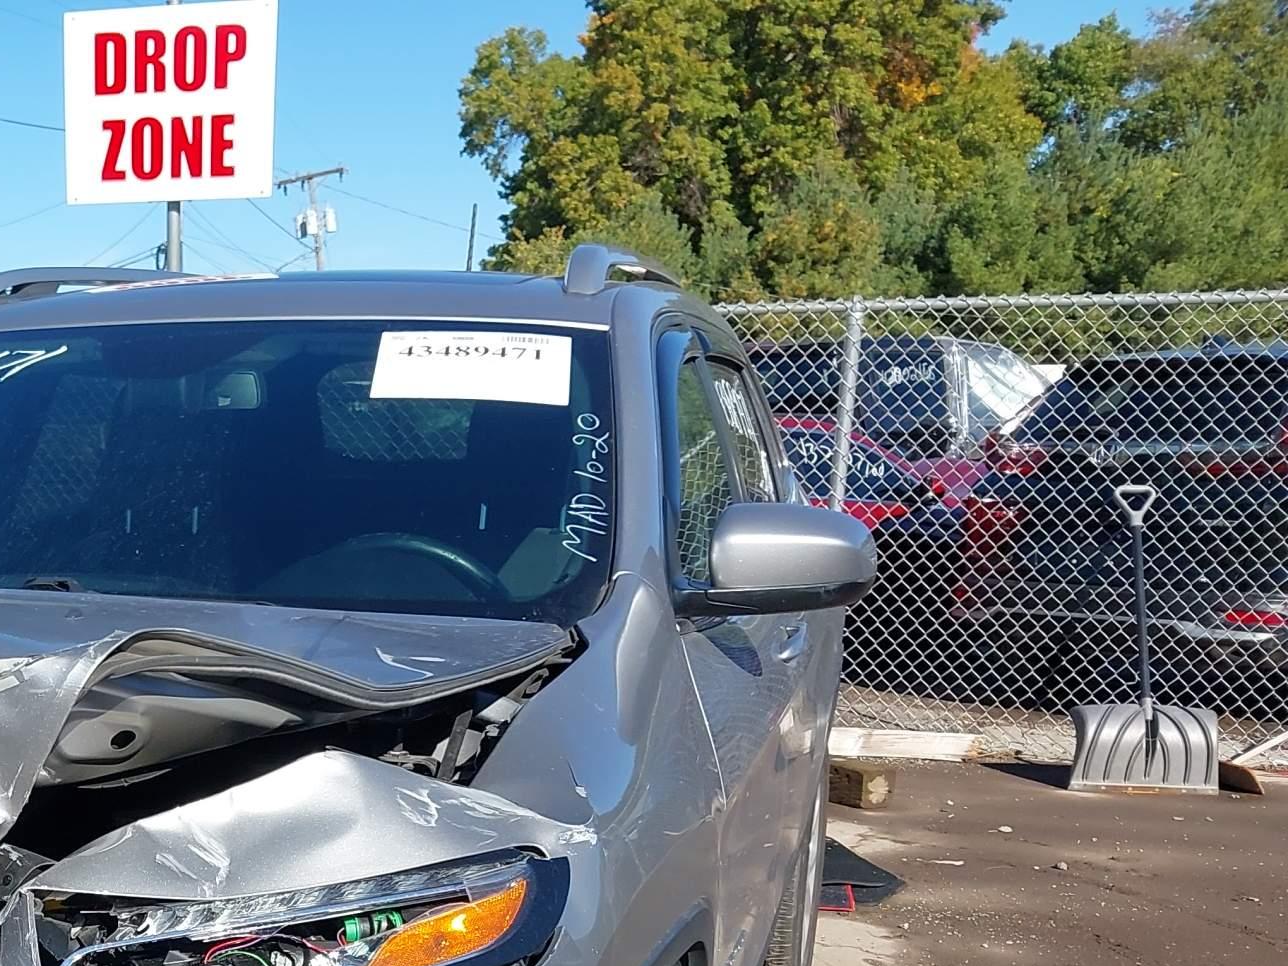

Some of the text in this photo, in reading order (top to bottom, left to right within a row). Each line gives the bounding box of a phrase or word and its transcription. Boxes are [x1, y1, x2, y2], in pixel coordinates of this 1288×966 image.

[94, 24, 247, 96] DROP
[101, 113, 235, 182] ZONE
[398, 345, 542, 360] 43489471
[562, 413, 610, 562] MAD 10-20
